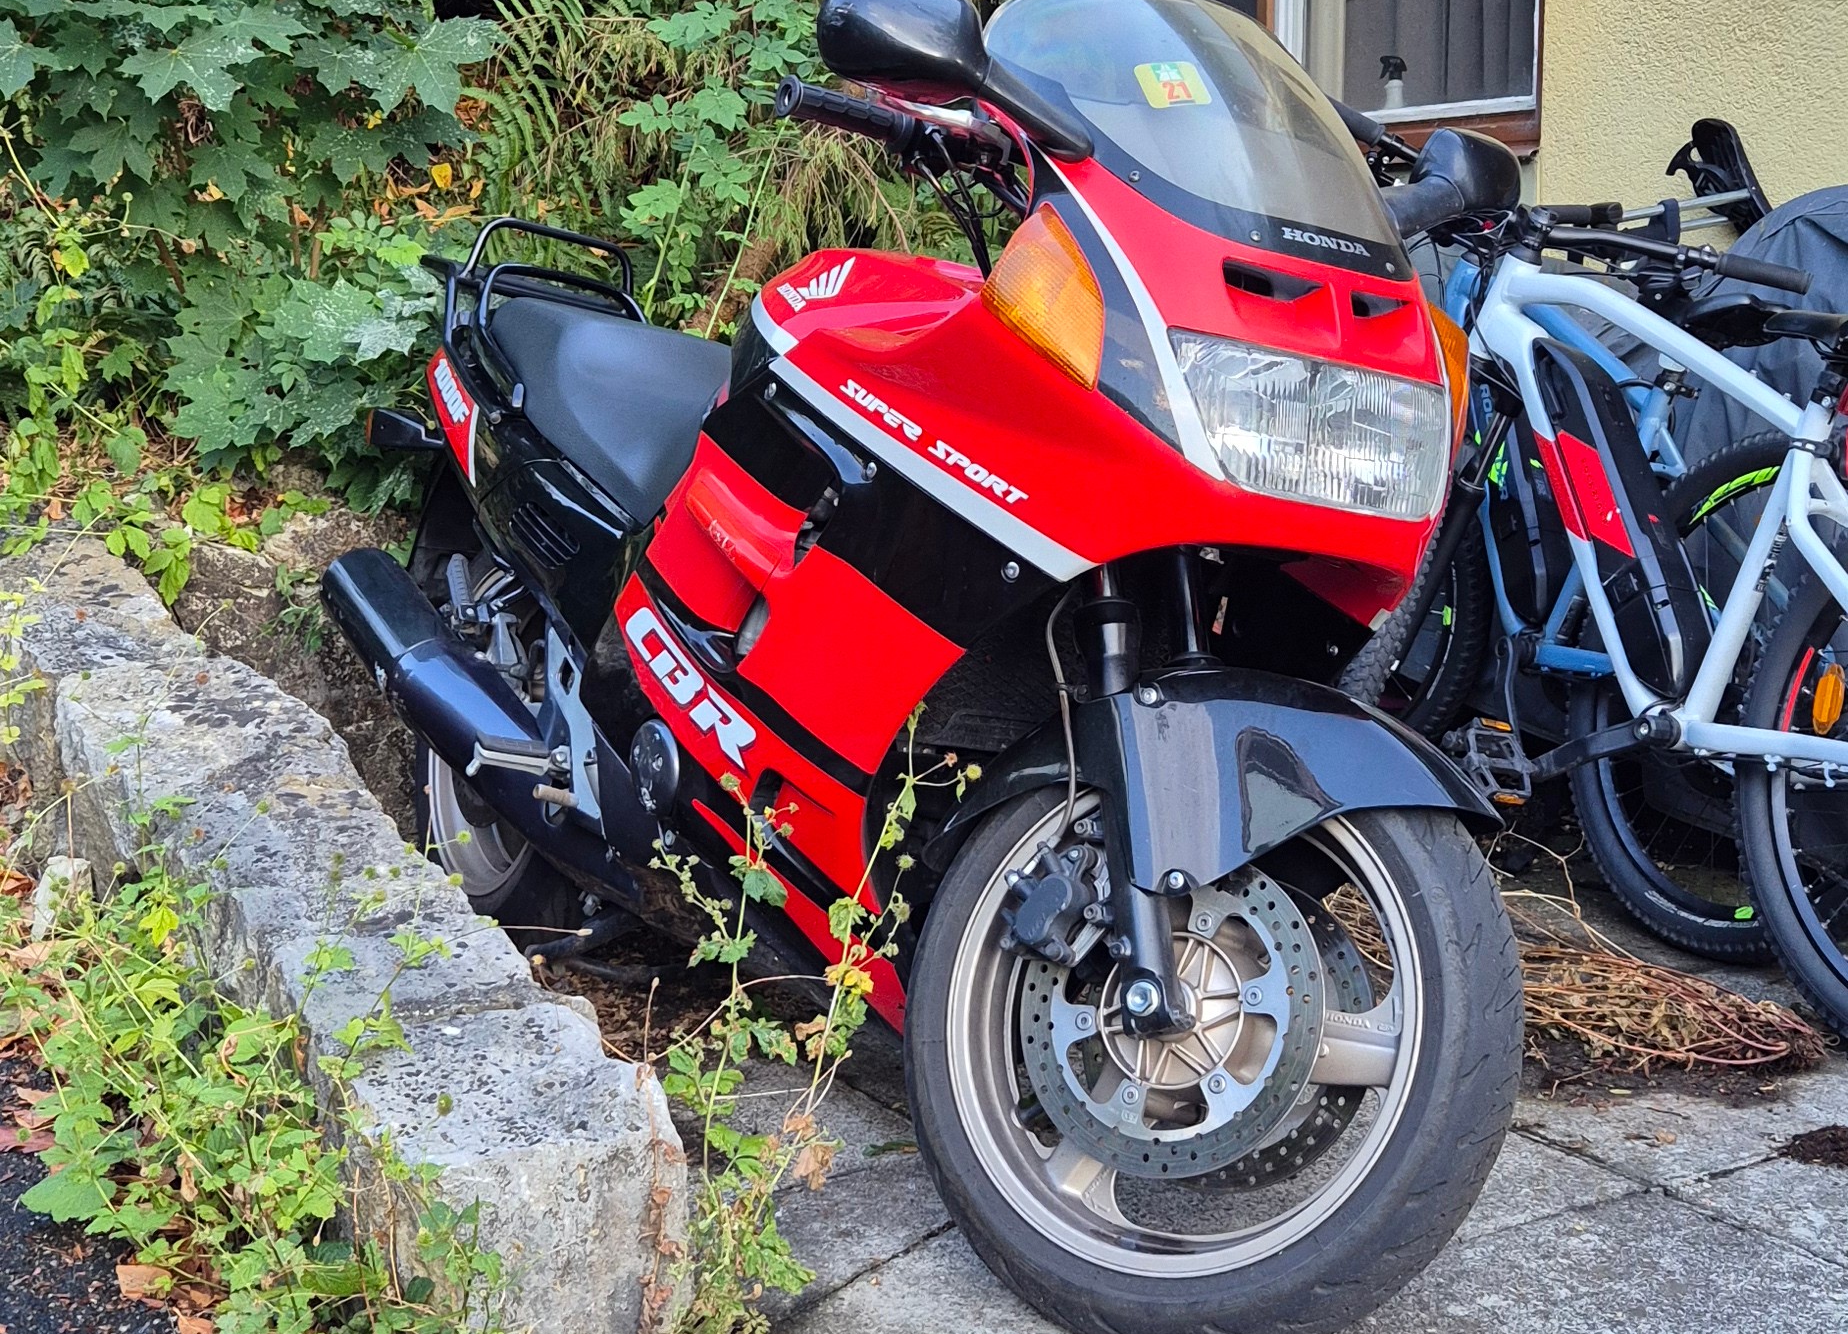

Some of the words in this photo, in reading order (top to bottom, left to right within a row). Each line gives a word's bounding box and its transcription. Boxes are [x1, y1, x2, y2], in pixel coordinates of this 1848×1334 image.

[1161, 81, 1192, 100] 21
[1281, 227, 1371, 257] HONDA
[776, 282, 807, 313] HONDA
[434, 358, 470, 424] 1000F
[839, 379, 923, 442] SUPER
[927, 439, 1029, 504] SPORT
[625, 607, 757, 770] CBR
[1325, 1011, 1371, 1029] HONDA
